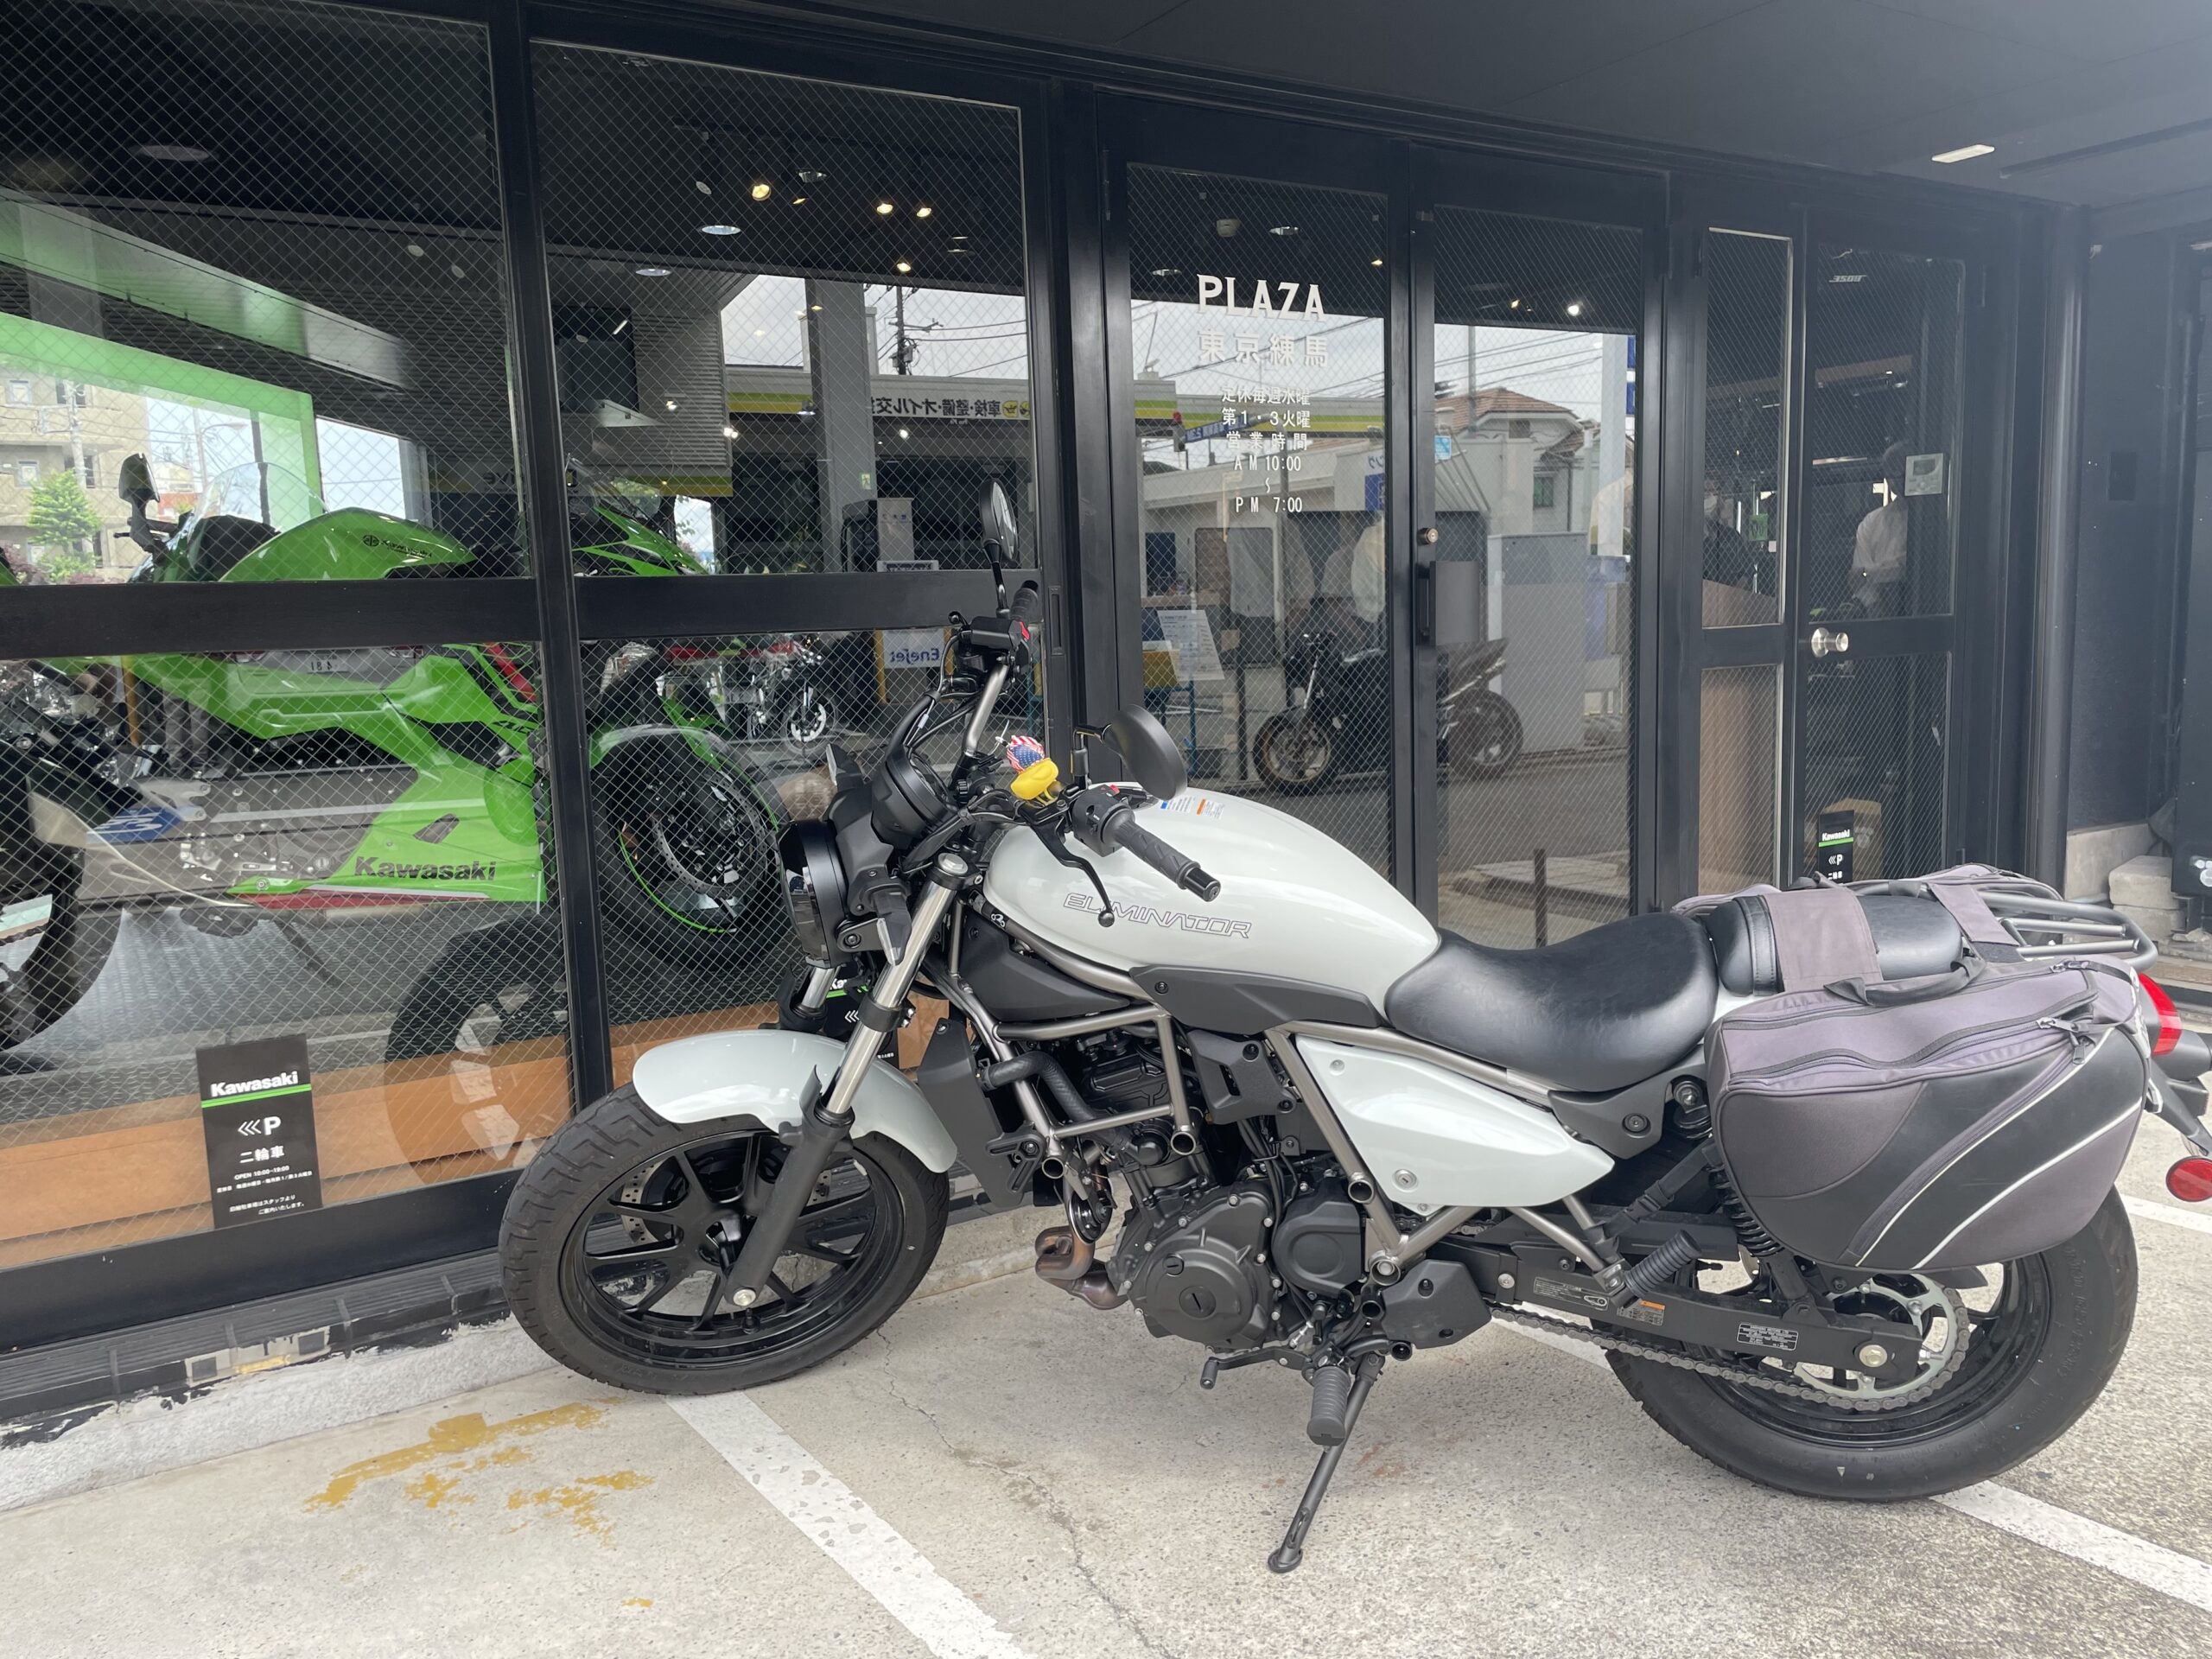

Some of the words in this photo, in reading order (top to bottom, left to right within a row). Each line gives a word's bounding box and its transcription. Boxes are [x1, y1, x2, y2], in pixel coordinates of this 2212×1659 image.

[1197, 274, 1327, 322] PLAZA
[1198, 329, 1329, 368] 東京練馬
[1221, 386, 1312, 406] 定休毎週水曜
[1226, 430, 1308, 451] 営業時間
[1265, 455, 1301, 472] 10:00
[1273, 497, 1303, 513] 7:00
[353, 855, 497, 880] Kawasaki
[1063, 893, 1252, 939] ELMINATOR
[210, 1071, 298, 1097] Kawasaki
[264, 1116, 282, 1135] P
[239, 1145, 285, 1164] 二輪車
[233, 1172, 252, 1180] OPEN
